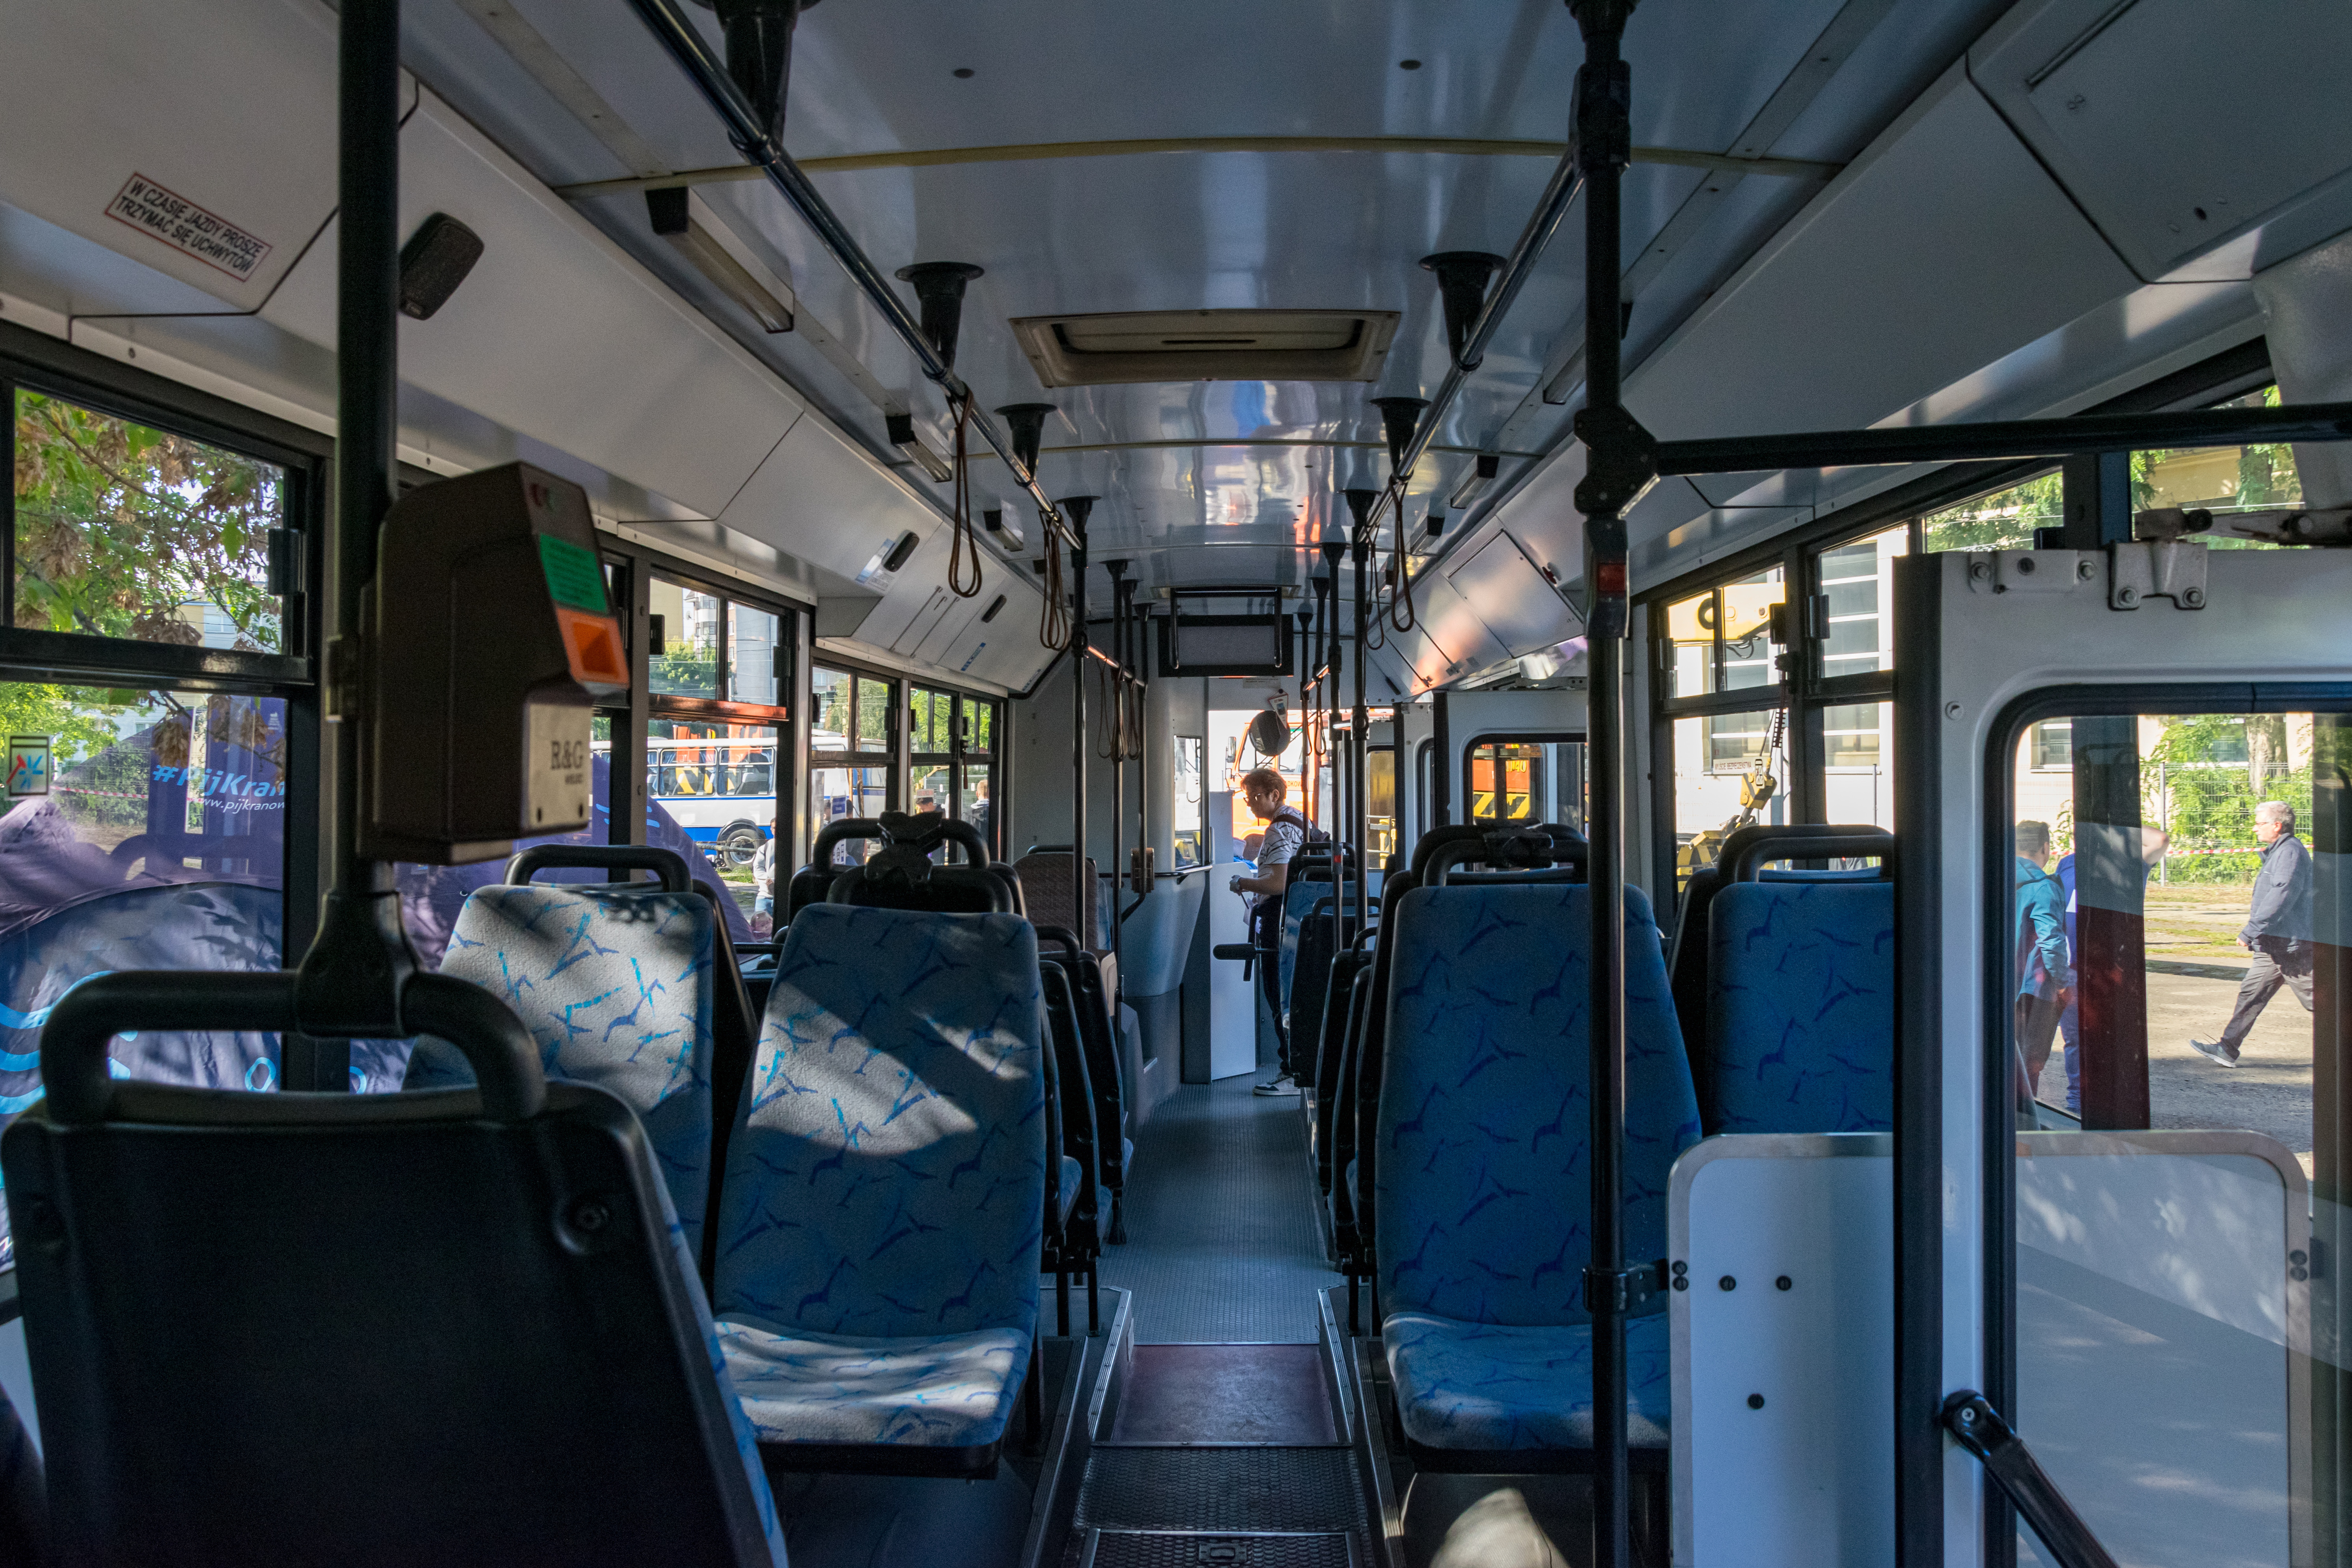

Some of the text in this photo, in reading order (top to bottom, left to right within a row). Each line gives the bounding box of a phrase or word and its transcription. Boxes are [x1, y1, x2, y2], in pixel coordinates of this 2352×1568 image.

[130, 180, 147, 197] W
[144, 188, 188, 219] CZASIE
[184, 210, 224, 236] JAZDY
[171, 224, 194, 246] SIĘ
[551, 740, 583, 769] R&G
